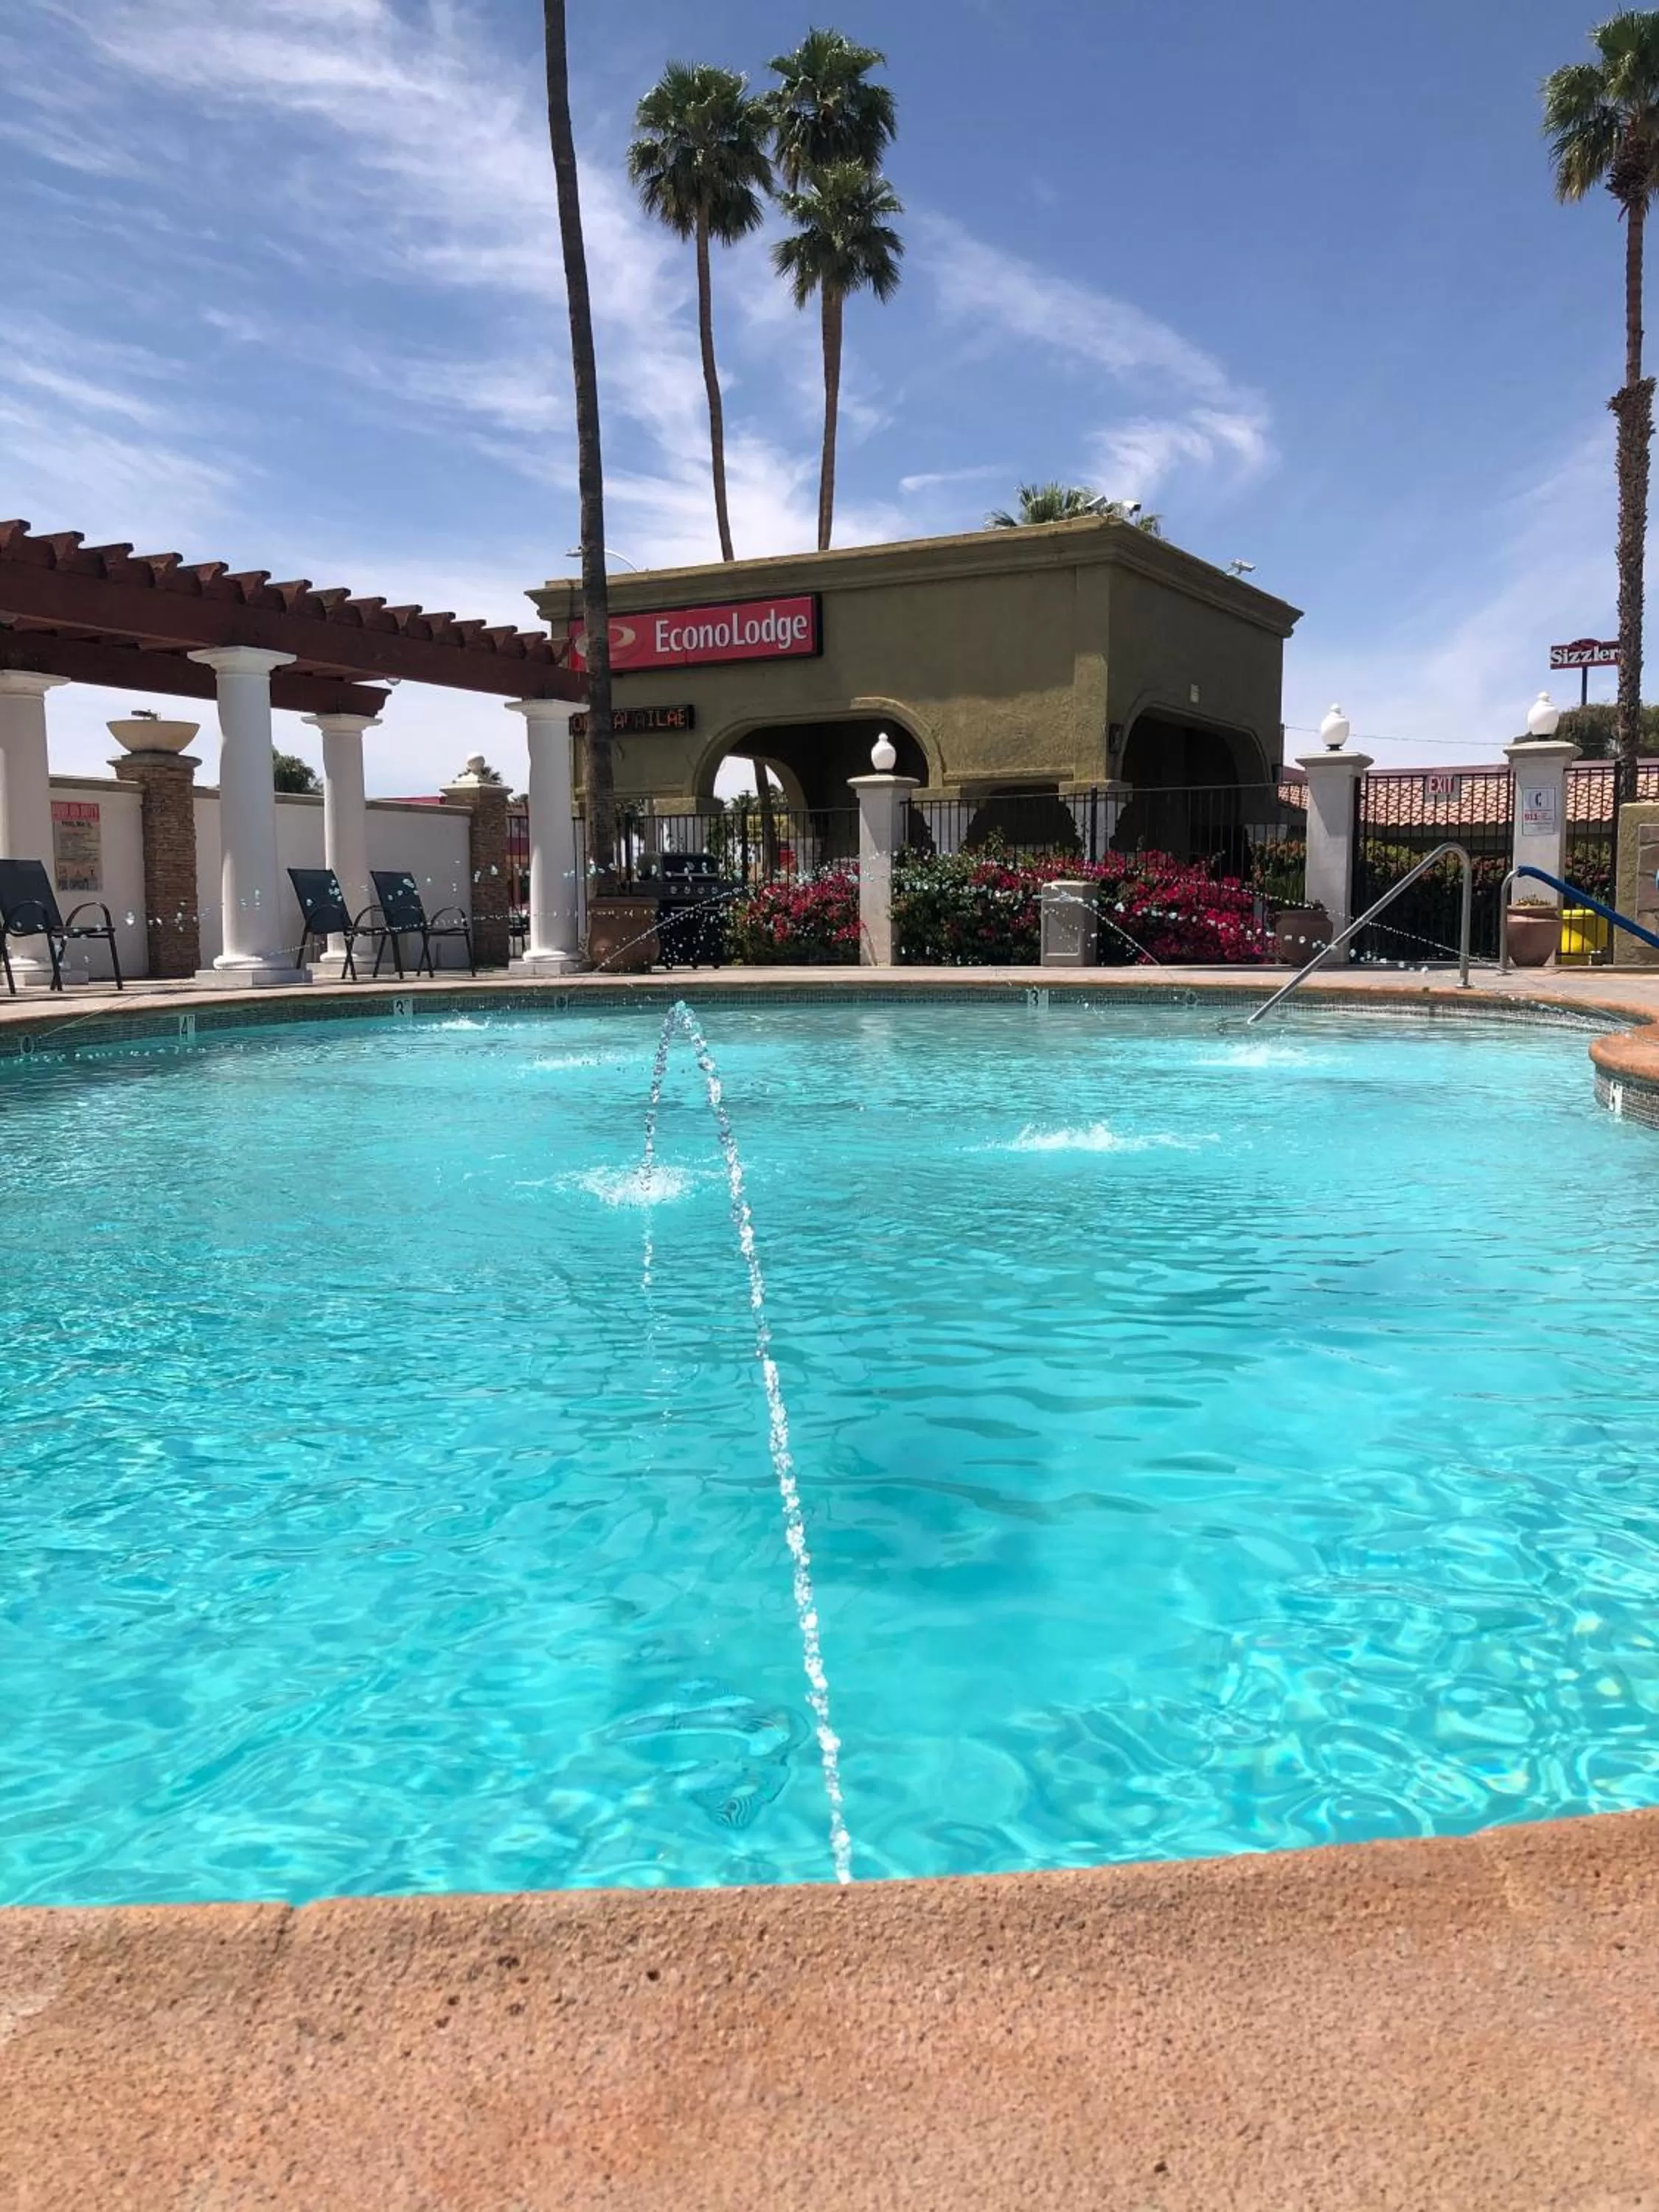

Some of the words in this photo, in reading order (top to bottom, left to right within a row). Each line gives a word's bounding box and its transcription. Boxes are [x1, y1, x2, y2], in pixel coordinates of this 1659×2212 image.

[655, 609, 807, 652] EconoLodge
[1551, 646, 1620, 664] Sizzler
[1428, 776, 1454, 794] EXIT
